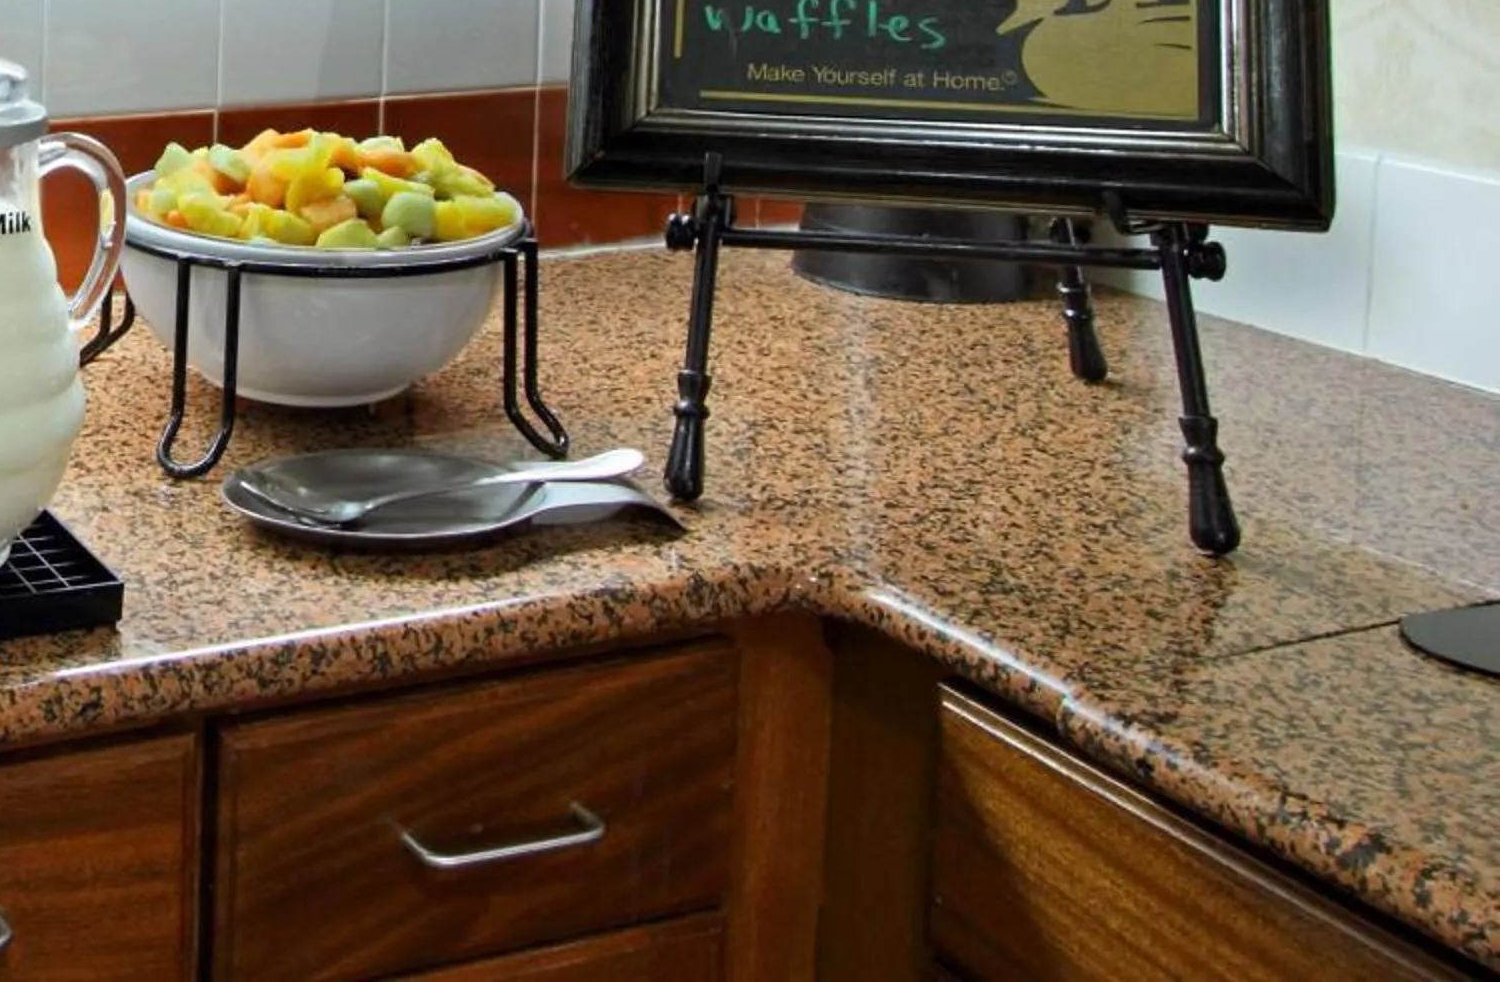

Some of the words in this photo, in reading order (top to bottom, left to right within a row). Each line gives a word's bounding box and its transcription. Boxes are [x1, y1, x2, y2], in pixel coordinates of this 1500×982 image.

[746, 62, 805, 83] Make
[813, 66, 896, 87] Yourself
[902, 70, 924, 88] at
